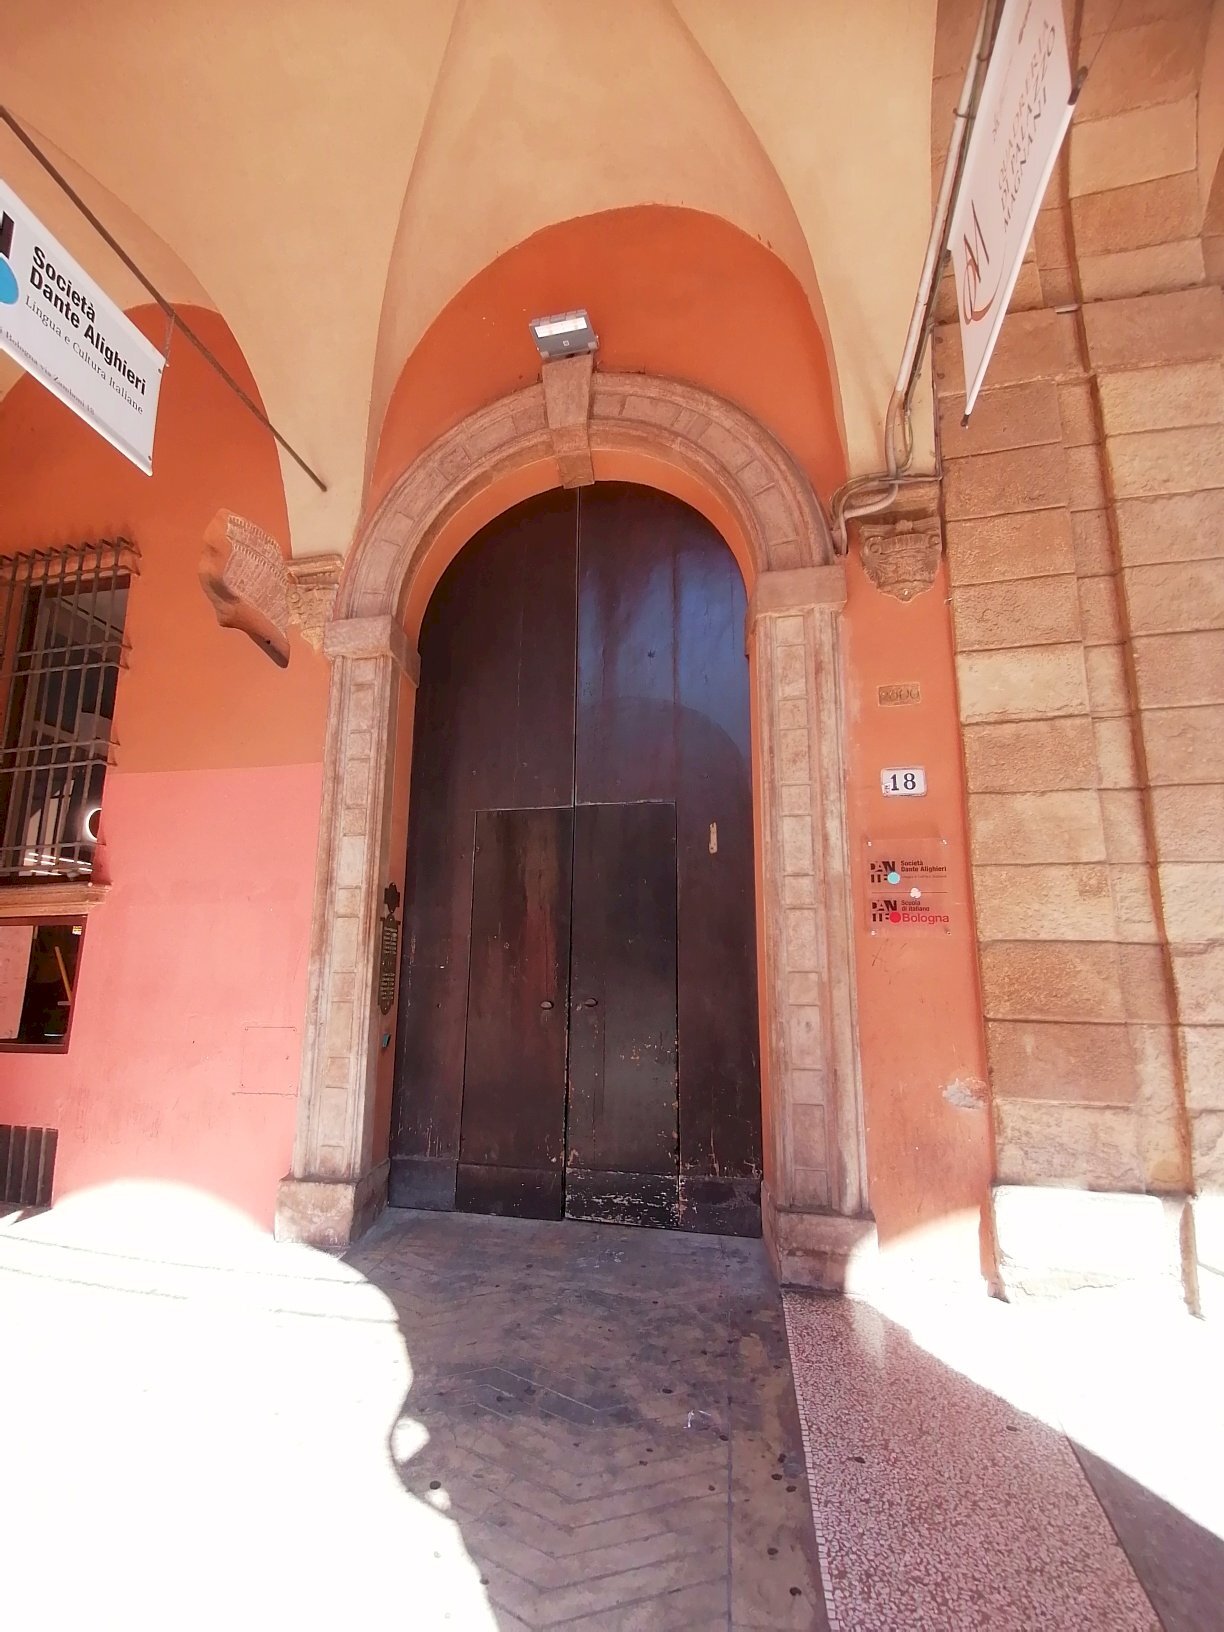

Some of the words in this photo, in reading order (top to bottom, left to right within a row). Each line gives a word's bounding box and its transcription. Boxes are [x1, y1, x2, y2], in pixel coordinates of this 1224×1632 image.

[1004, 86, 1046, 233] MAGNANI
[30, 265, 80, 329] Dante
[84, 324, 146, 395] Alighieri
[33, 246, 96, 323] Società
[25, 295, 62, 337] Lingua
[64, 335, 71, 345] e
[72, 342, 106, 380] Cultura
[109, 377, 143, 414] Italiane
[890, 773, 916, 790] 18
[902, 913, 949, 924] Bologna
